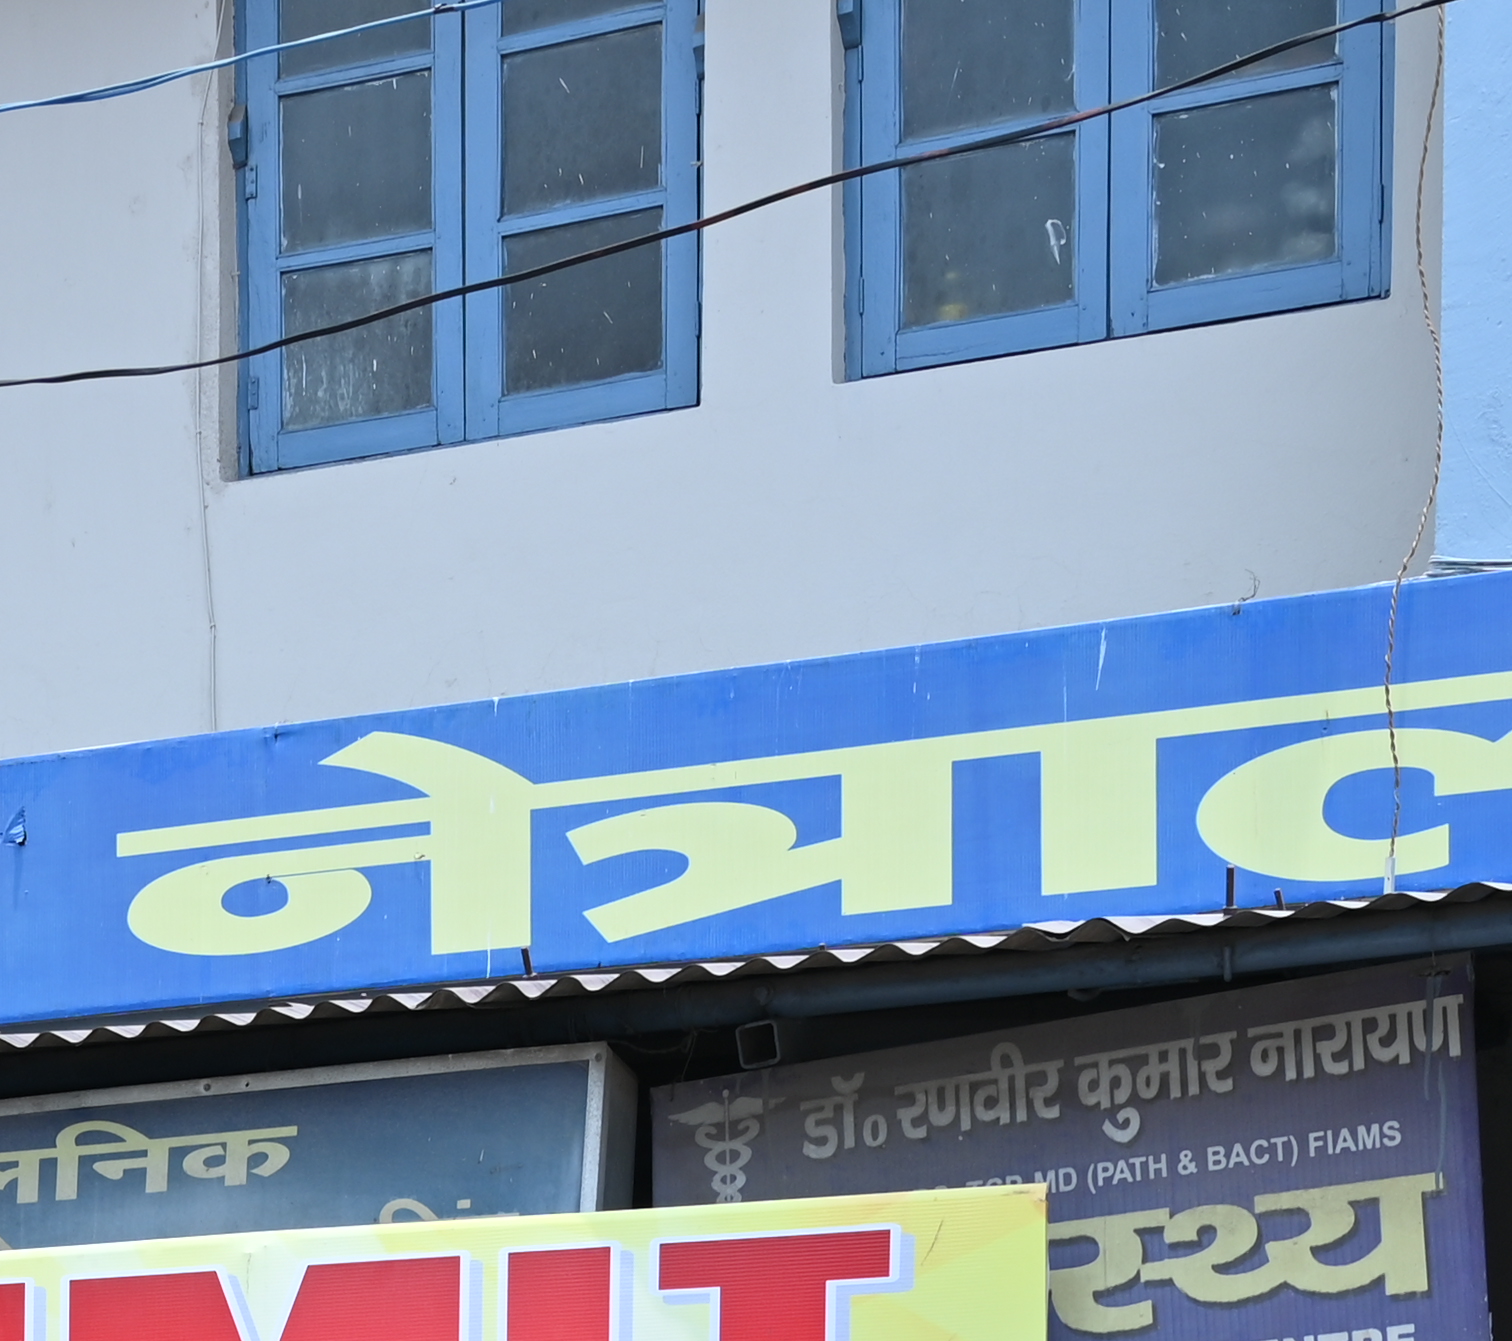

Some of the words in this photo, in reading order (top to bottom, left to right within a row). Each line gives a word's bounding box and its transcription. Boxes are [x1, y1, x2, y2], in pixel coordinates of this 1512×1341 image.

[894, 1044, 1064, 1142] रणवीर
[1074, 1031, 1237, 1142] कुमार
[1249, 993, 1465, 1084] नारायण
[1087, 1153, 1167, 1195] (PATH
[1177, 1150, 1198, 1176] &
[1207, 1134, 1299, 1172] BACT)
[1309, 1120, 1402, 1158] FIAMS
